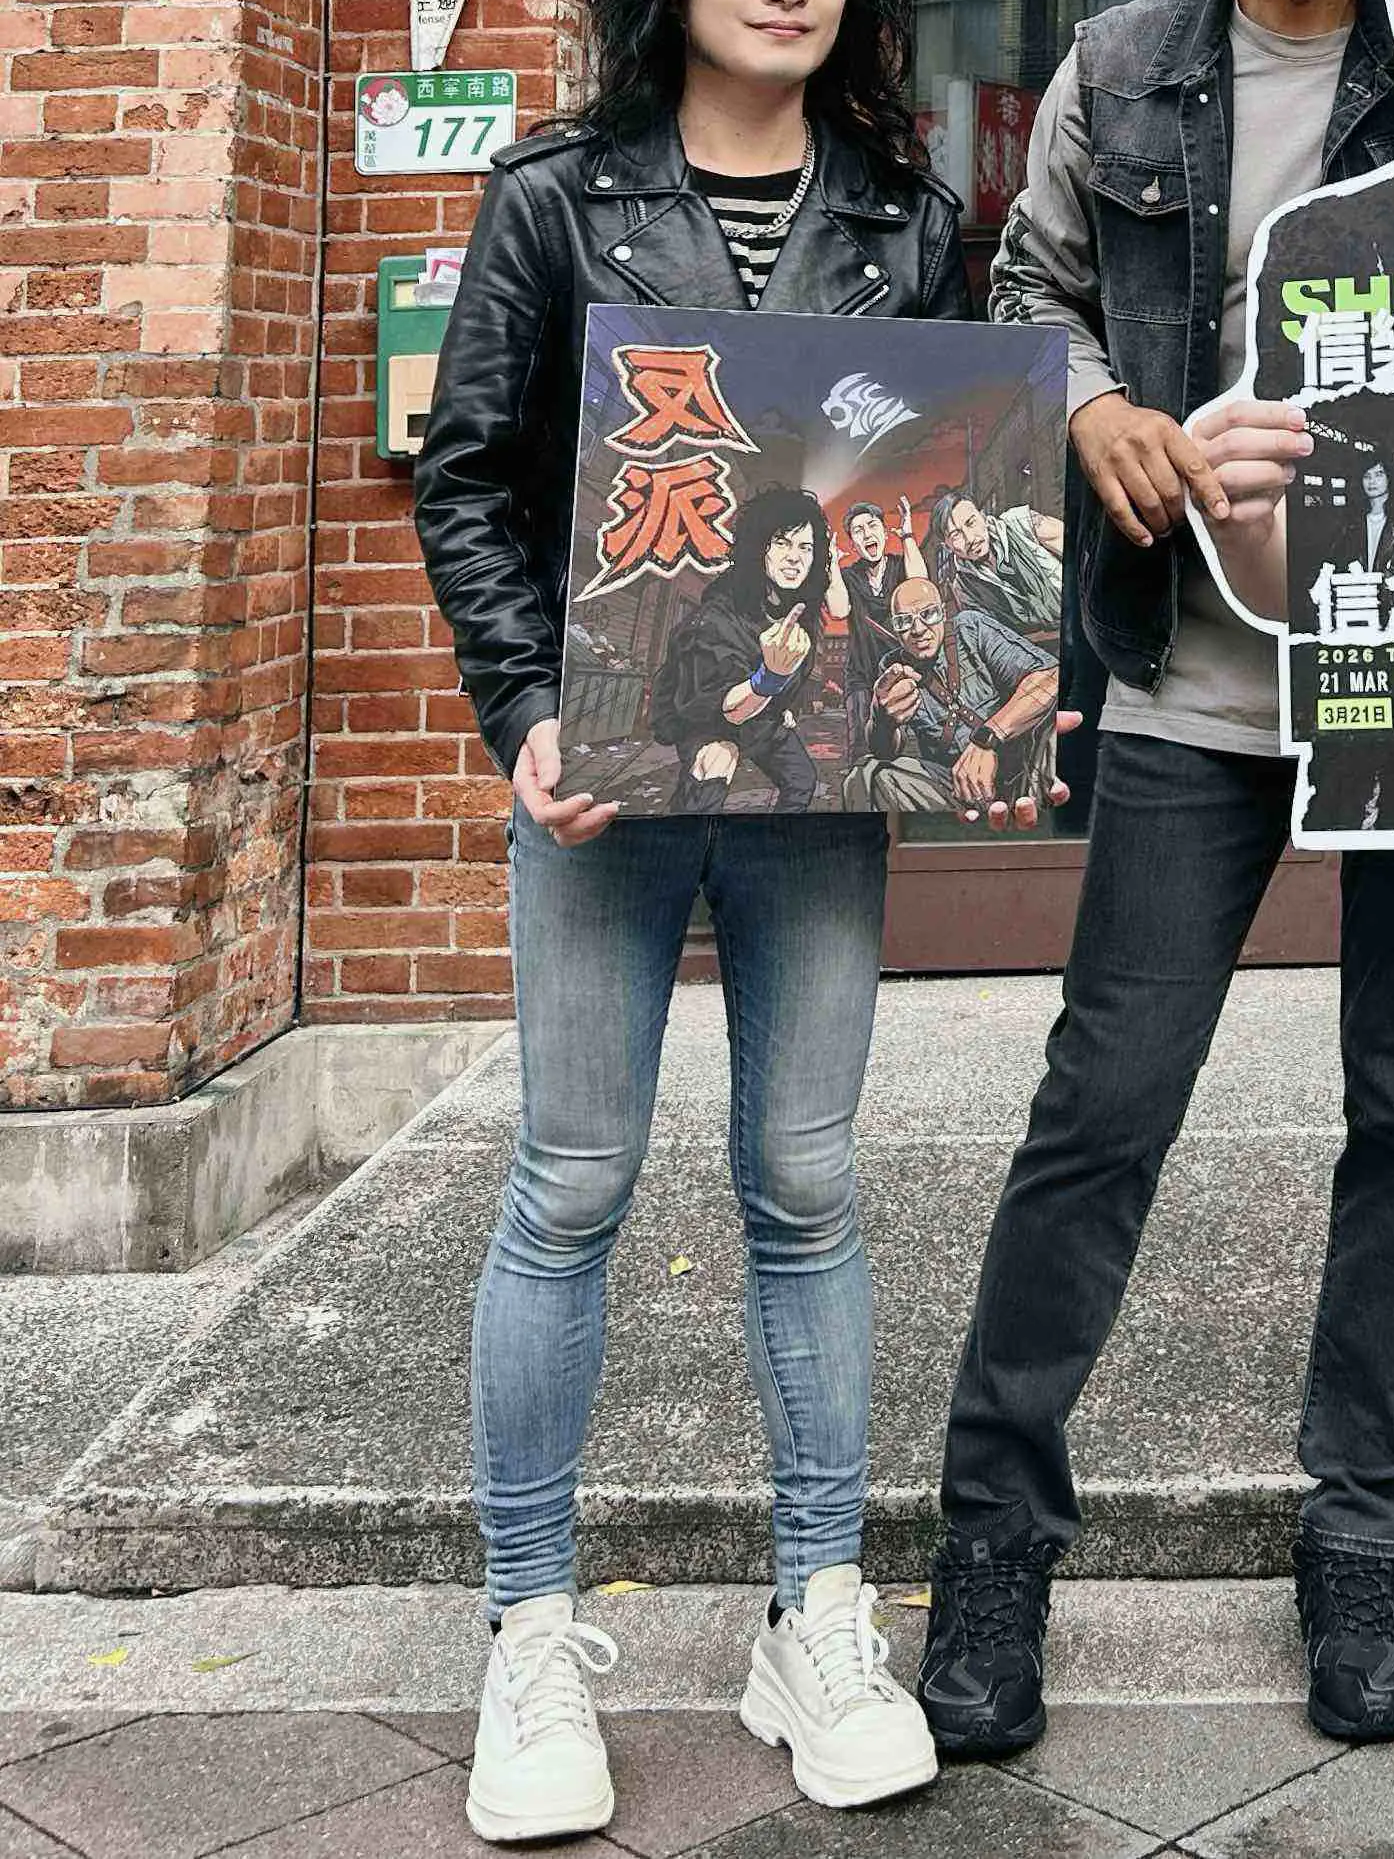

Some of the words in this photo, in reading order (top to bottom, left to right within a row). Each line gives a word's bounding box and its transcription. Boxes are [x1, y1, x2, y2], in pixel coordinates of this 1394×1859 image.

[416, 75, 510, 99] 西寧南路
[413, 115, 497, 158] 177
[1317, 648, 1375, 665] 2026
[1319, 672, 1340, 693] 21
[1350, 671, 1389, 692] MAR
[1324, 706, 1386, 725] 3月21日
